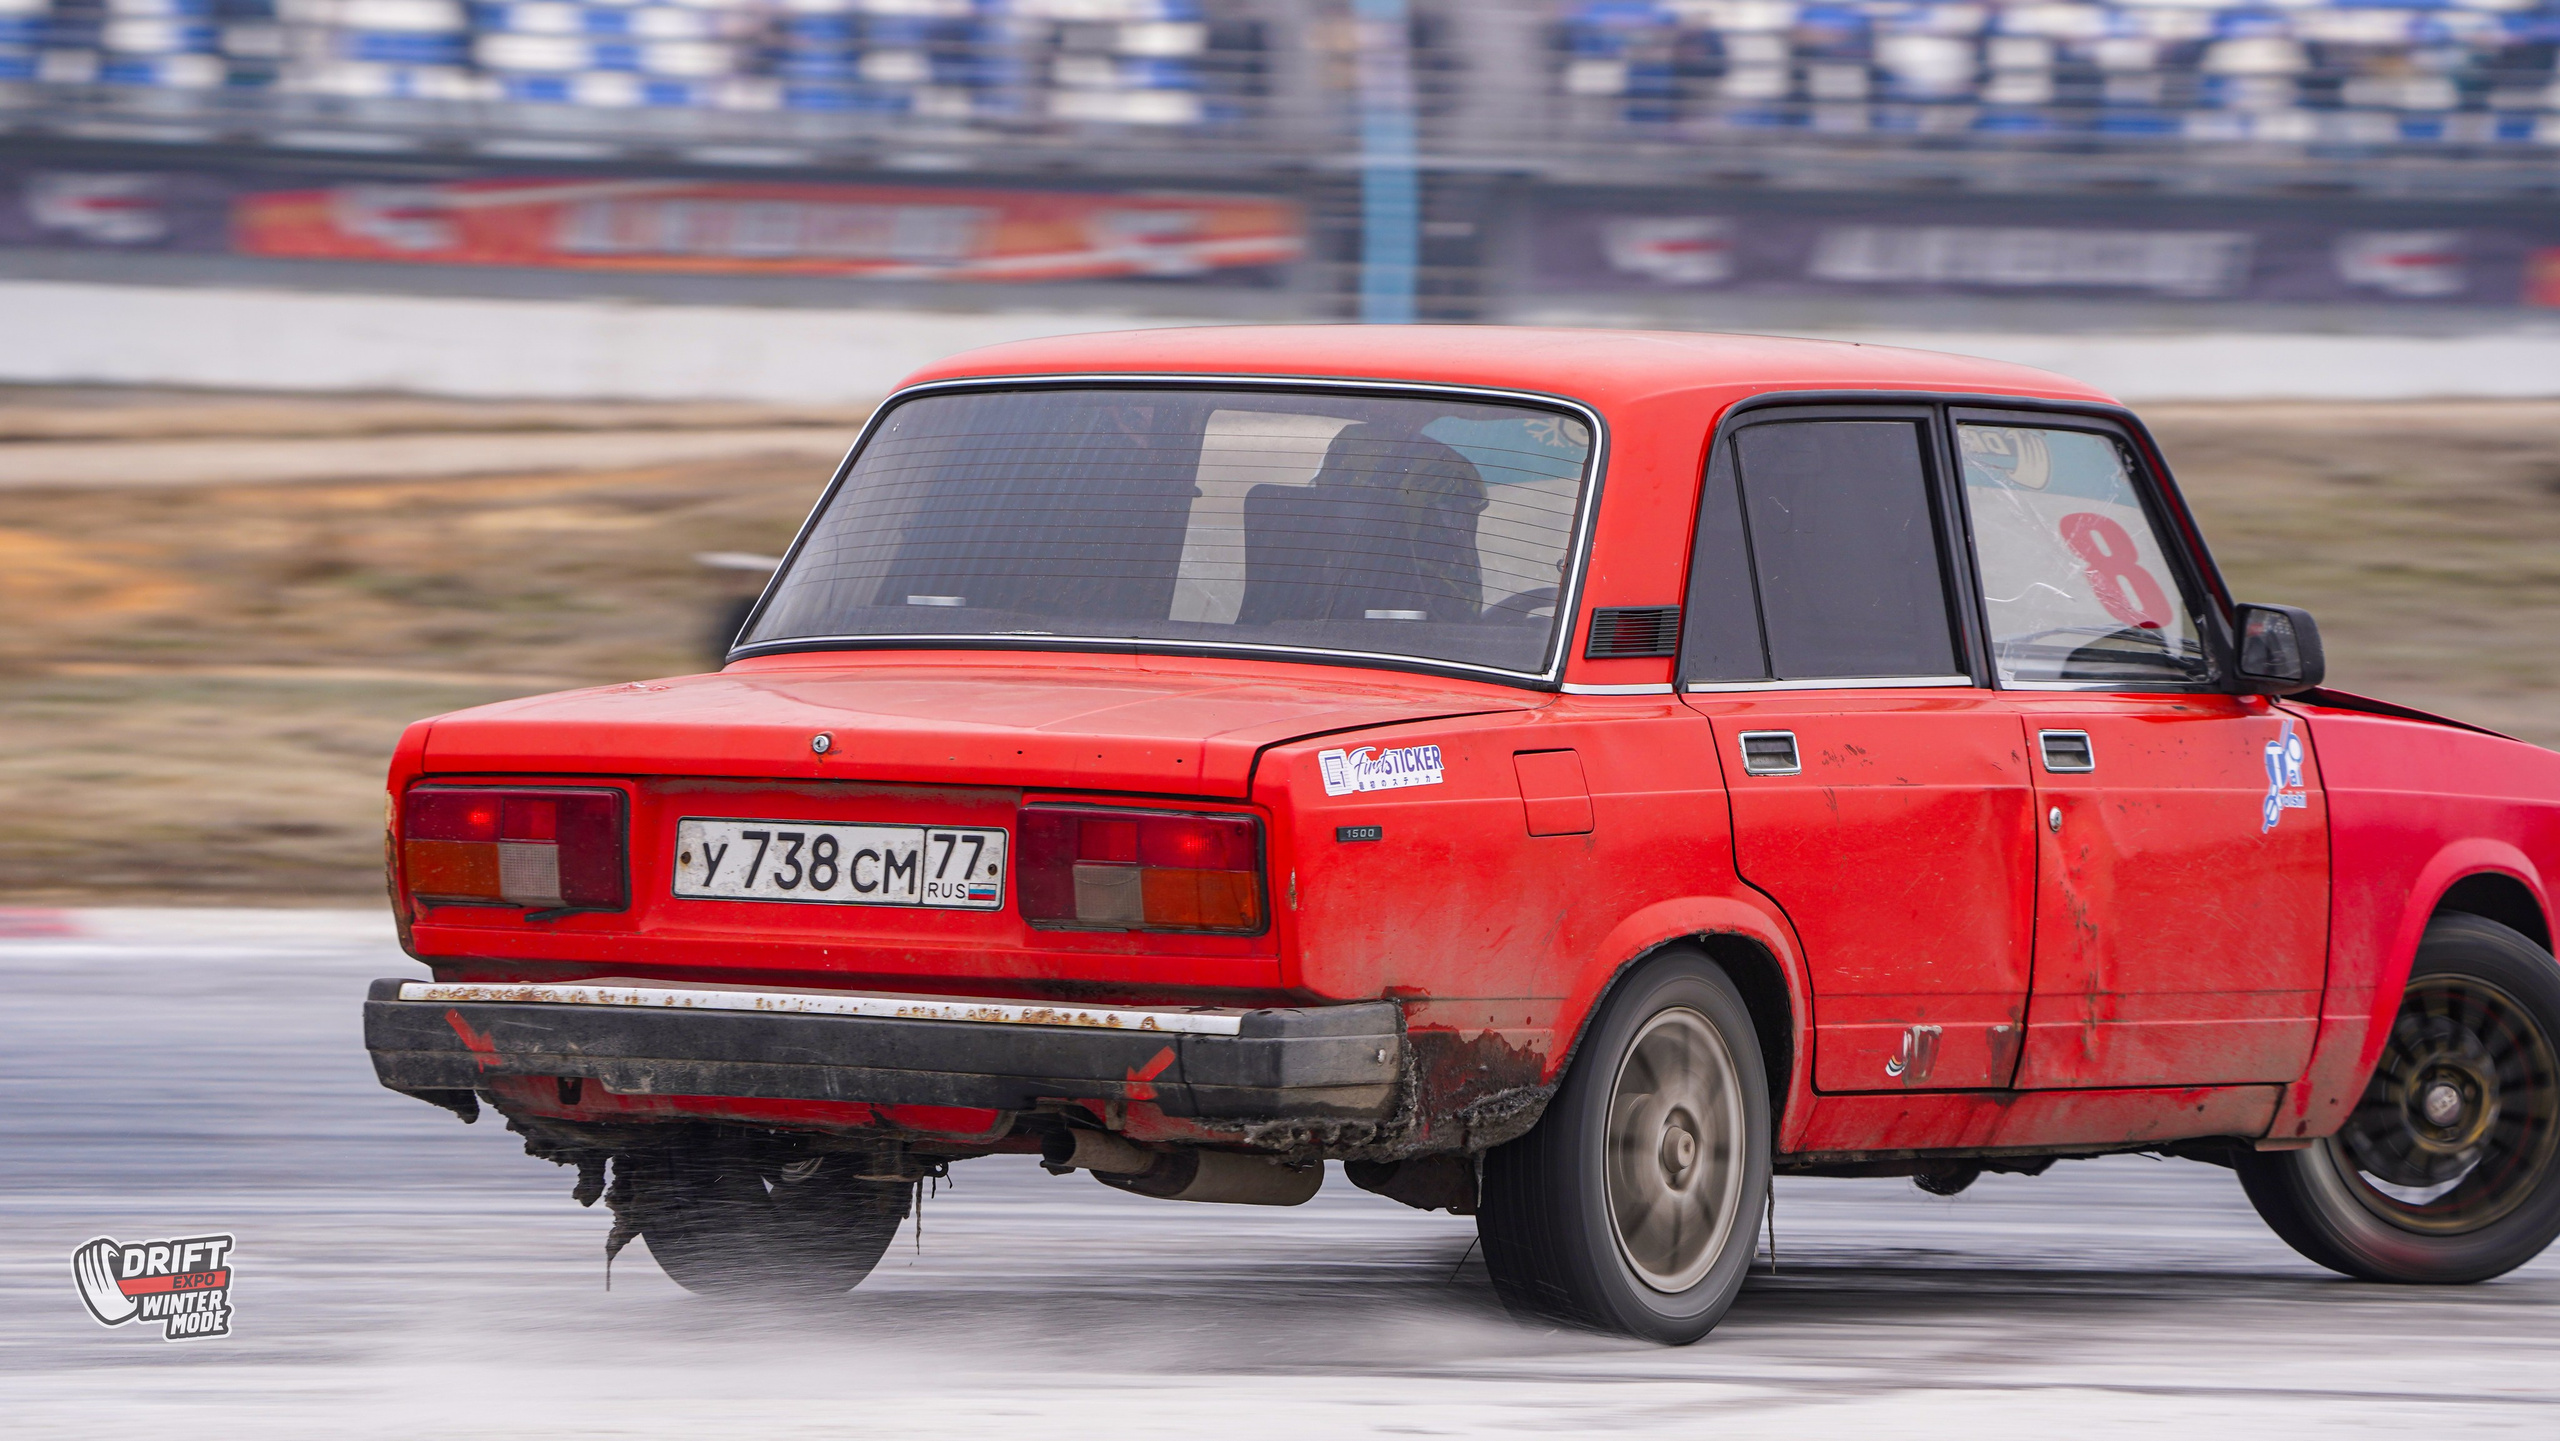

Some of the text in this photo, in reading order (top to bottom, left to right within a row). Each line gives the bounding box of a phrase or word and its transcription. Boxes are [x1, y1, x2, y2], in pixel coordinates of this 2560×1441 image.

[2058, 512, 2174, 629] 8
[1346, 828, 1375, 838] 1500
[932, 833, 986, 881] 77
[926, 882, 967, 899] RUS
